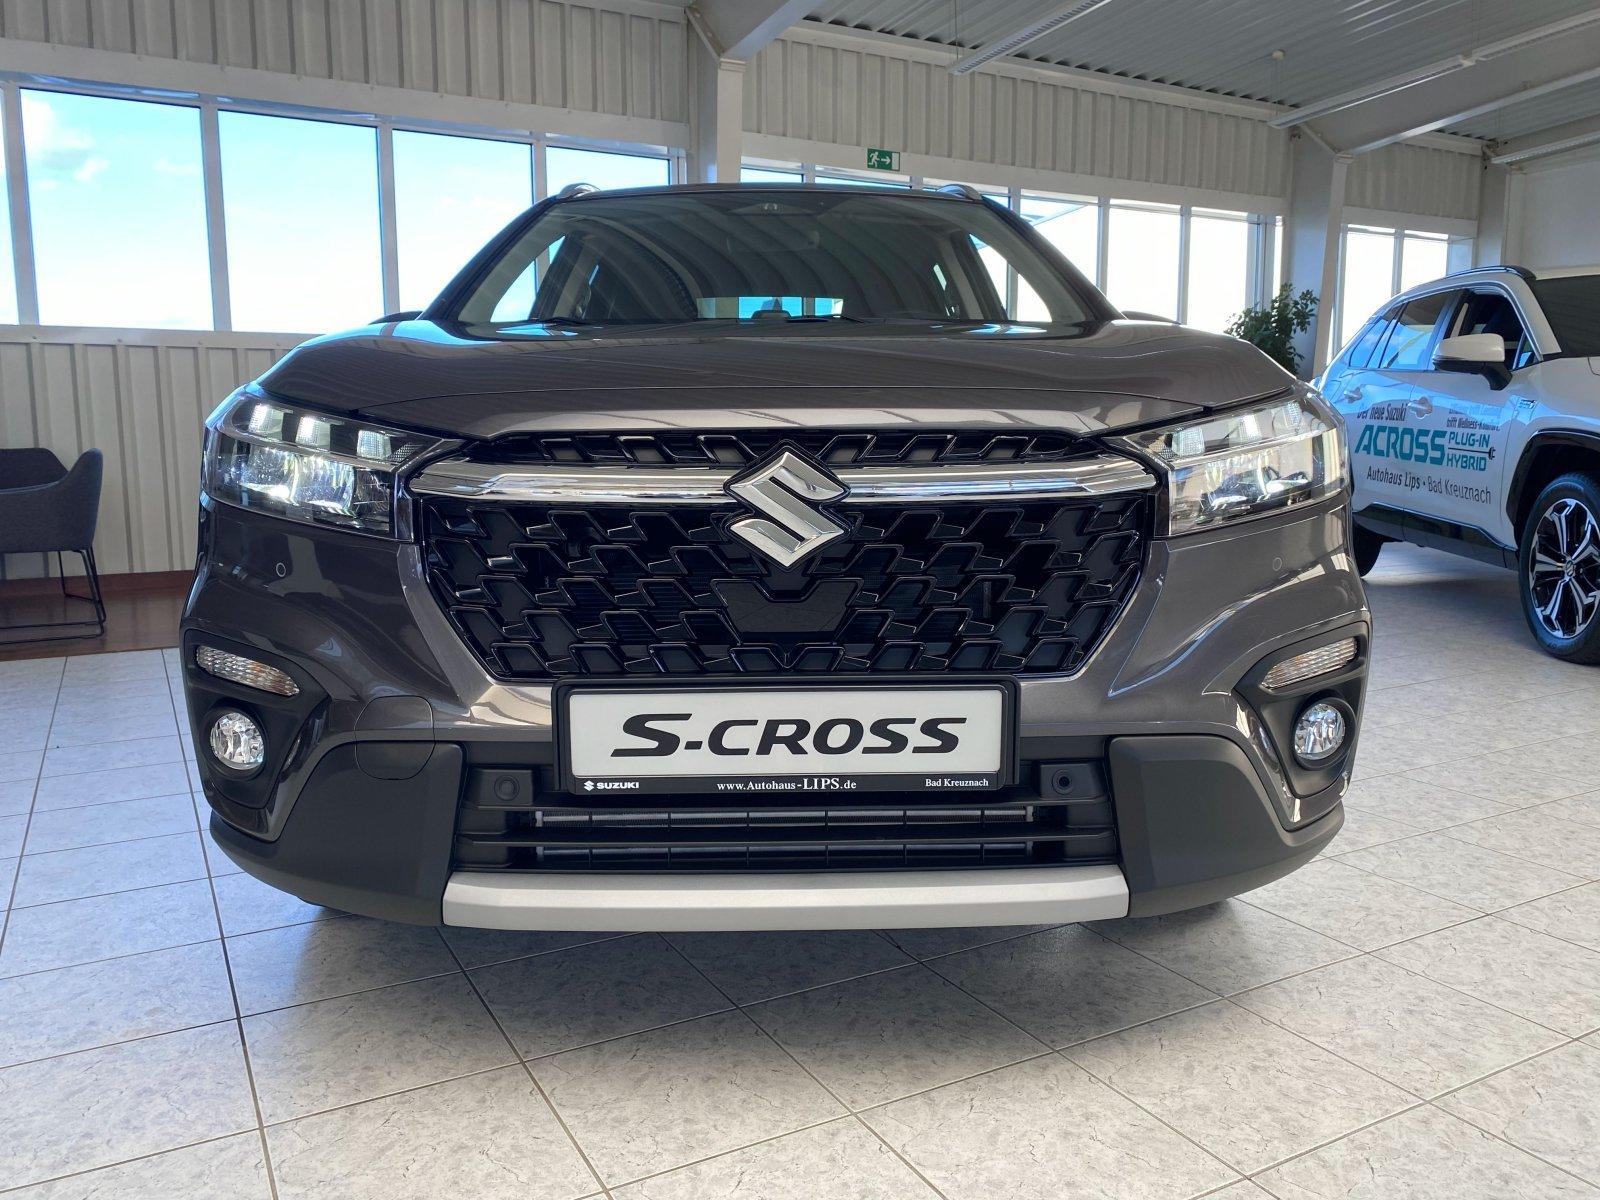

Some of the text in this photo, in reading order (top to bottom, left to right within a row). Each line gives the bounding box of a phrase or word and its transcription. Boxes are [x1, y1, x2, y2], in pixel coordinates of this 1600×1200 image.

[1369, 406, 1385, 420] neue
[1385, 403, 1408, 421] Suzuki
[1354, 424, 1448, 466] ACROSS
[1448, 431, 1490, 448] PLUG-IN
[1446, 454, 1487, 471] HYBRID
[1366, 465, 1491, 504] Autohaus Lips Bad Kreuznach
[610, 712, 967, 757] S-CROSS
[596, 781, 639, 789] SUZUKI
[716, 777, 857, 791] www.Autohaus-LIPS.de
[925, 778, 989, 787] Bad Kreuznach
